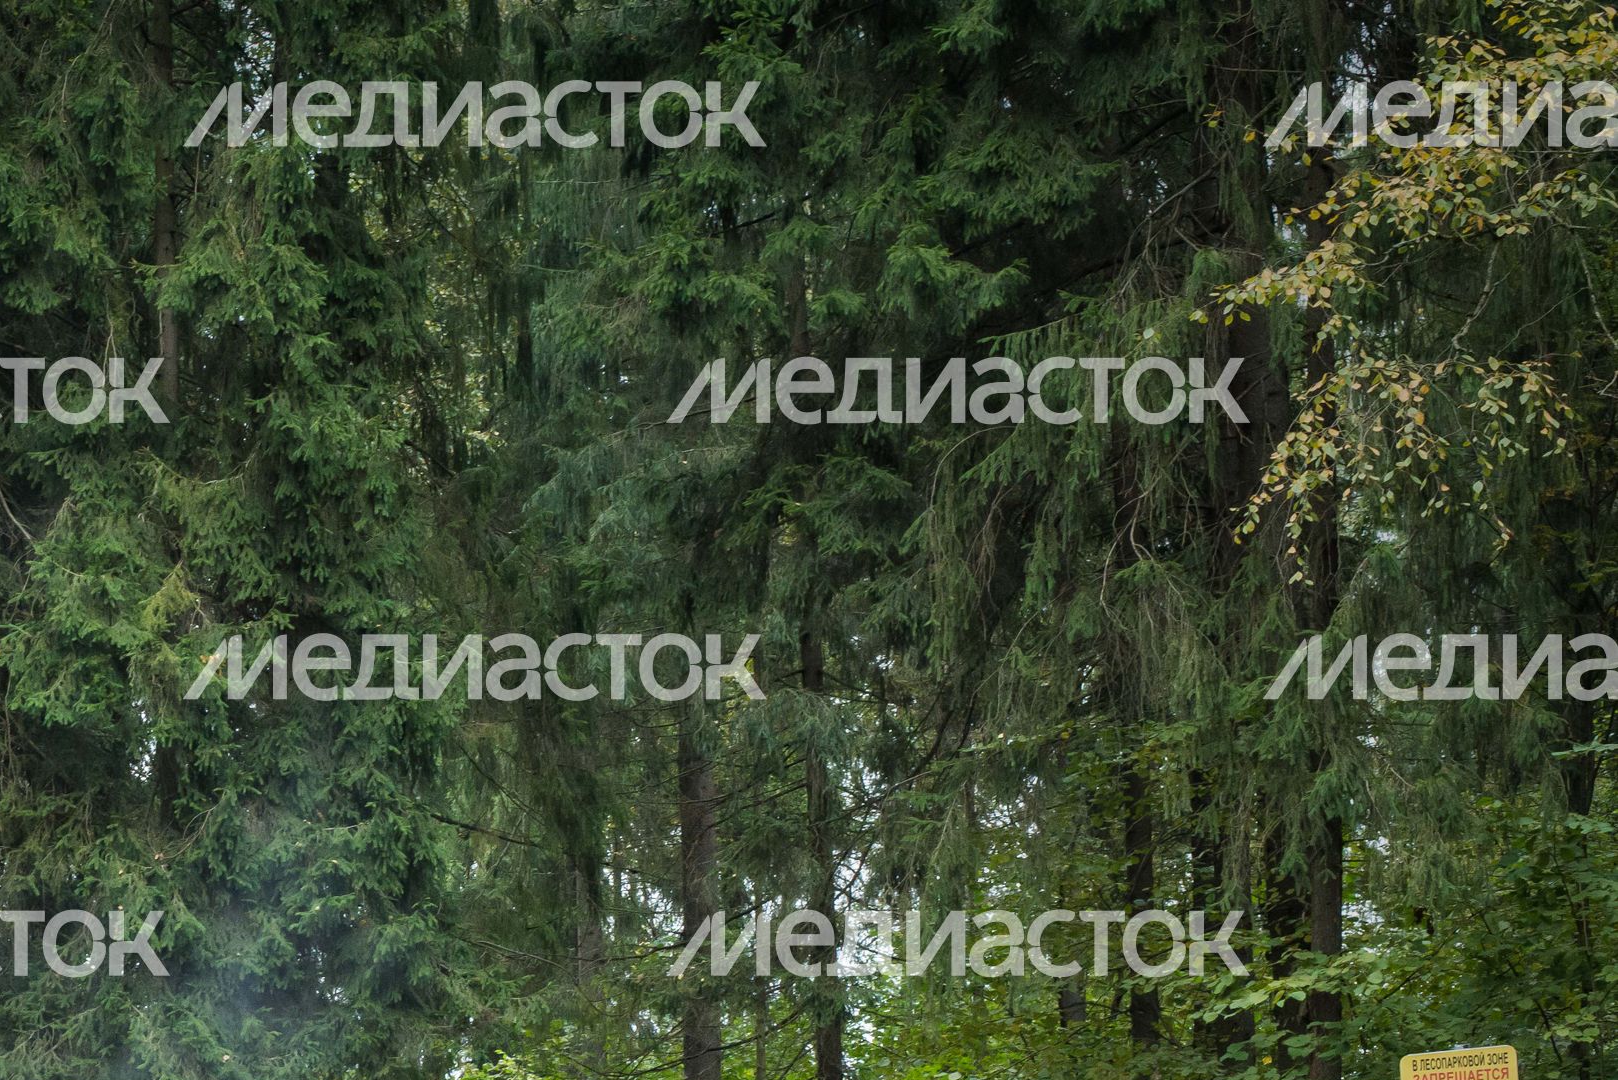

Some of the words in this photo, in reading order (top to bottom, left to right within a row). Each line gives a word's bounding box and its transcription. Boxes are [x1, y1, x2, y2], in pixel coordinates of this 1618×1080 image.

[1412, 1059, 1418, 1072] В
[1420, 1052, 1485, 1071] ЛЕСОПАРКОВОЙ
[1487, 1052, 1509, 1065] ЗОНЕ
